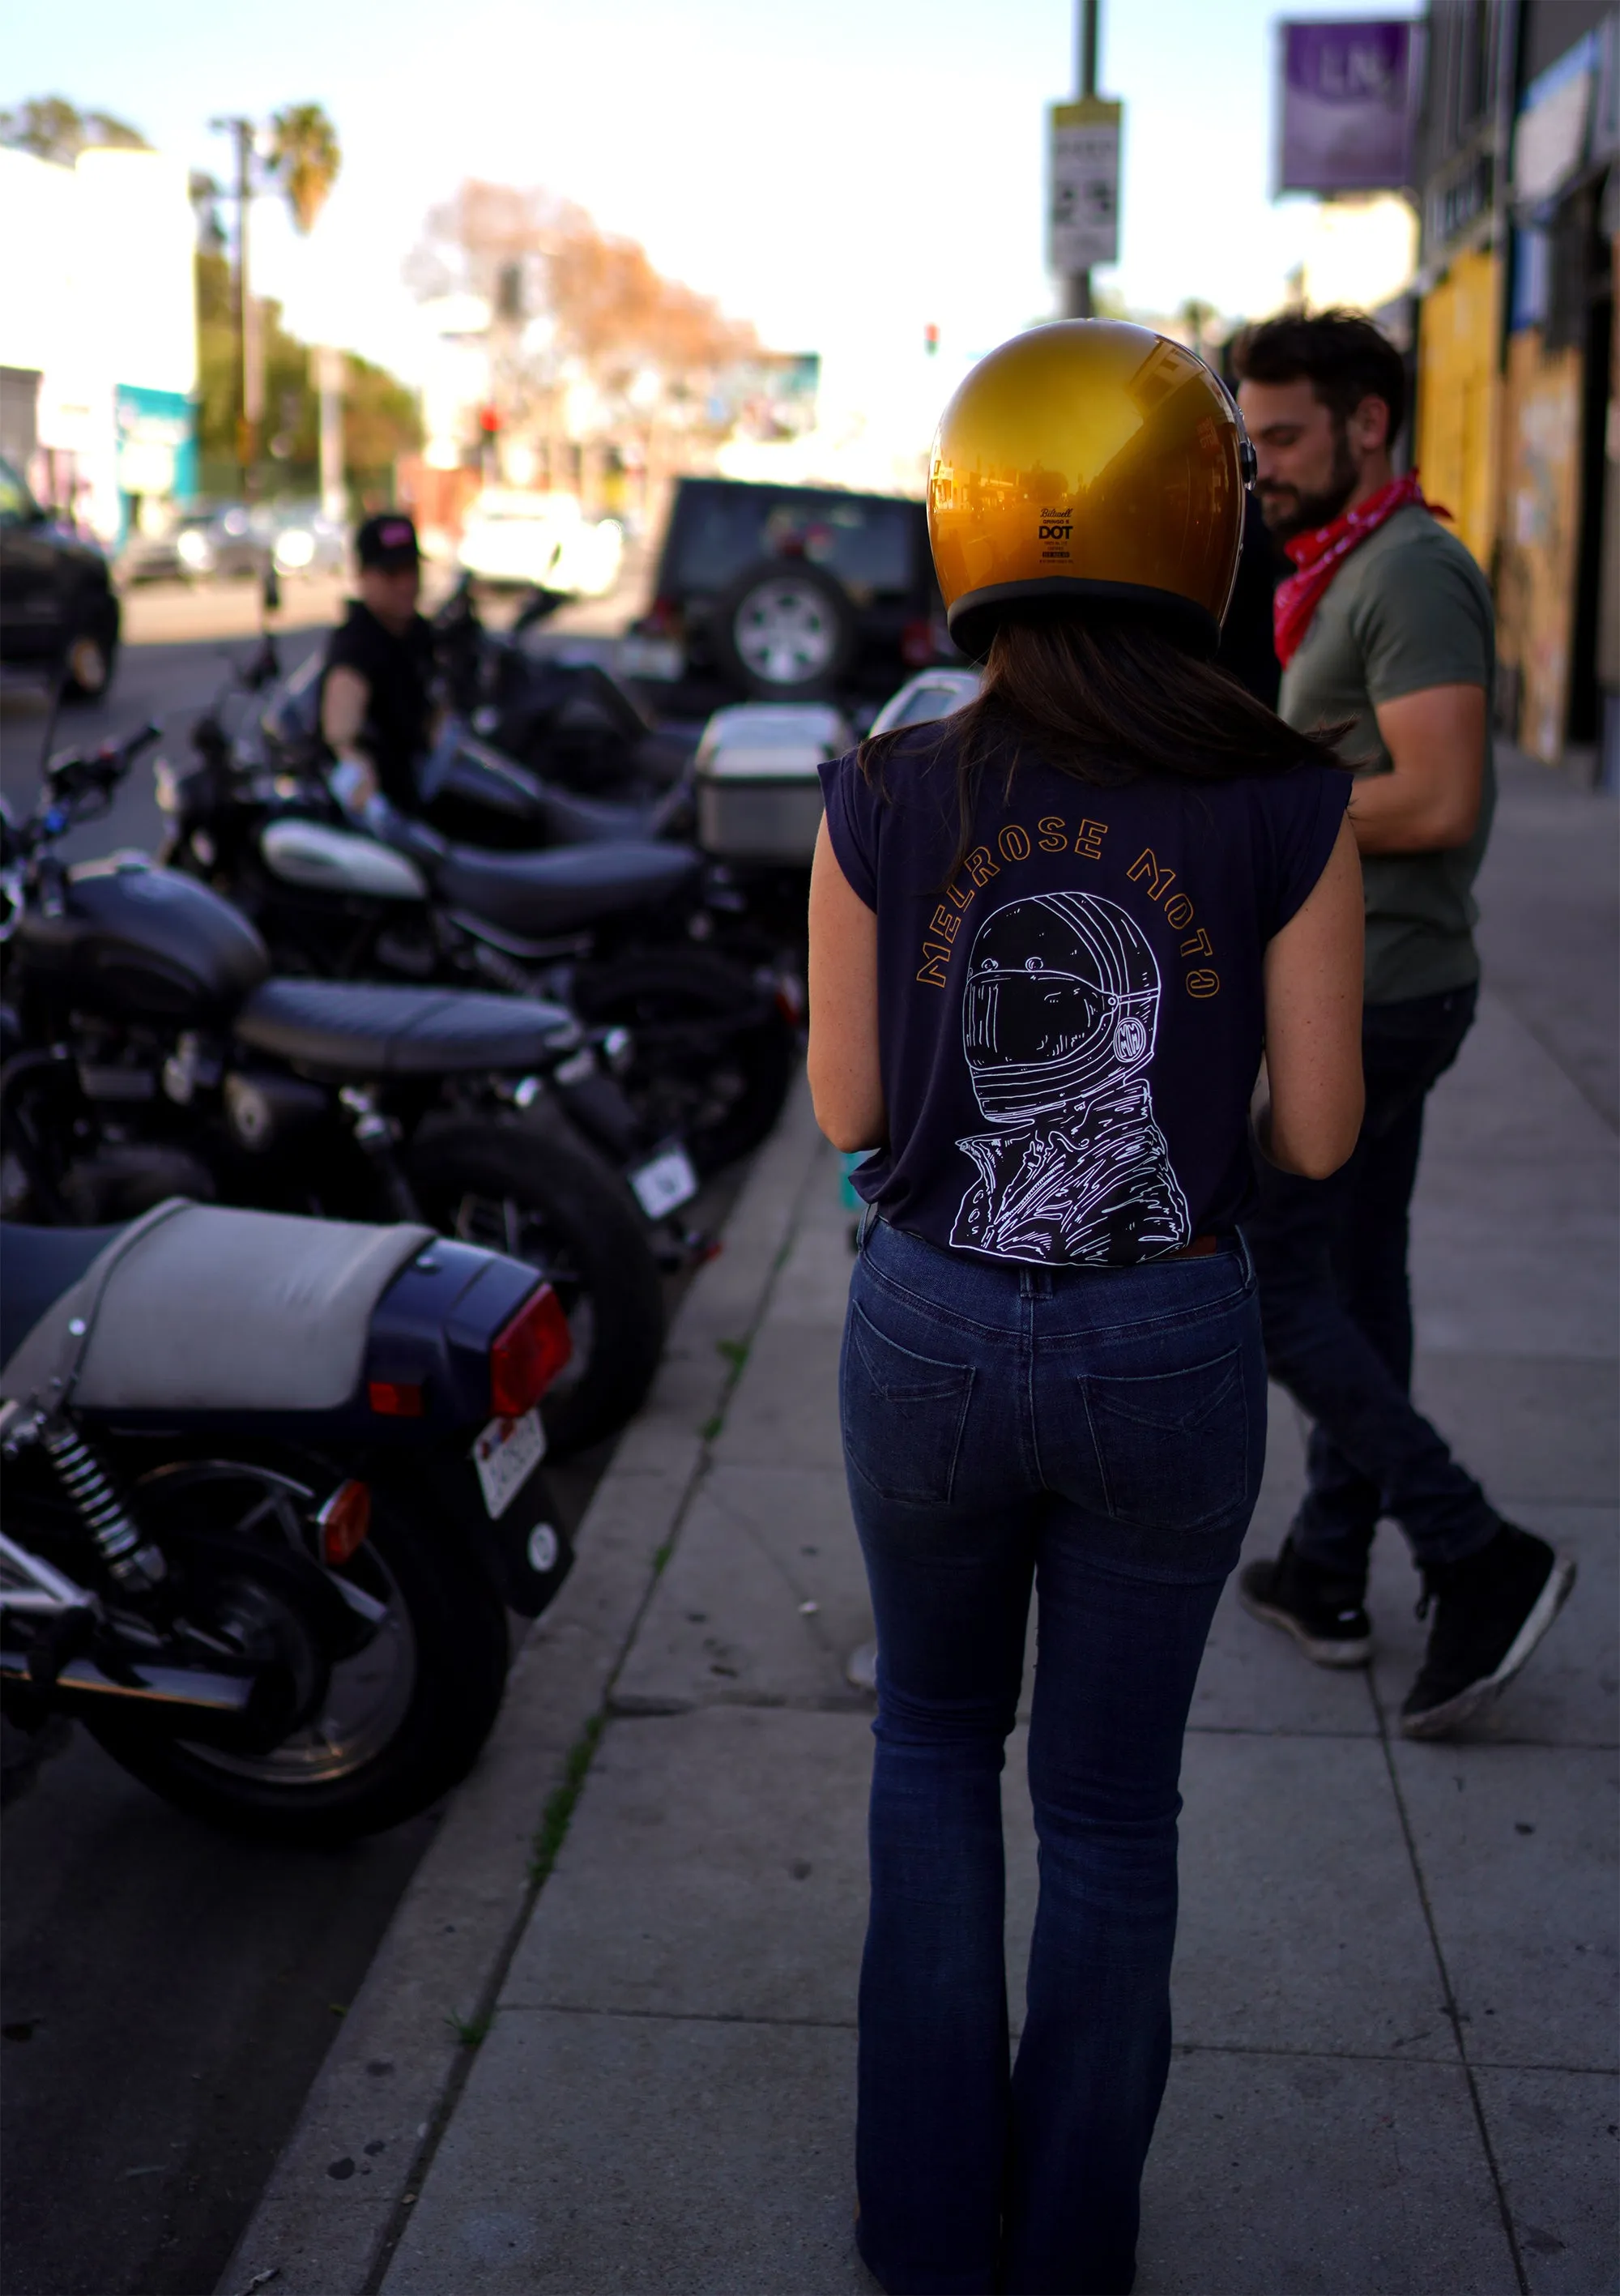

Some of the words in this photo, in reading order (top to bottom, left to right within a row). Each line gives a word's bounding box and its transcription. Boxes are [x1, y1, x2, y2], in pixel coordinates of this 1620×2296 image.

[1038, 525, 1073, 540] DOT
[916, 817, 1108, 988] MELROSE
[1126, 848, 1220, 998] MOTO
